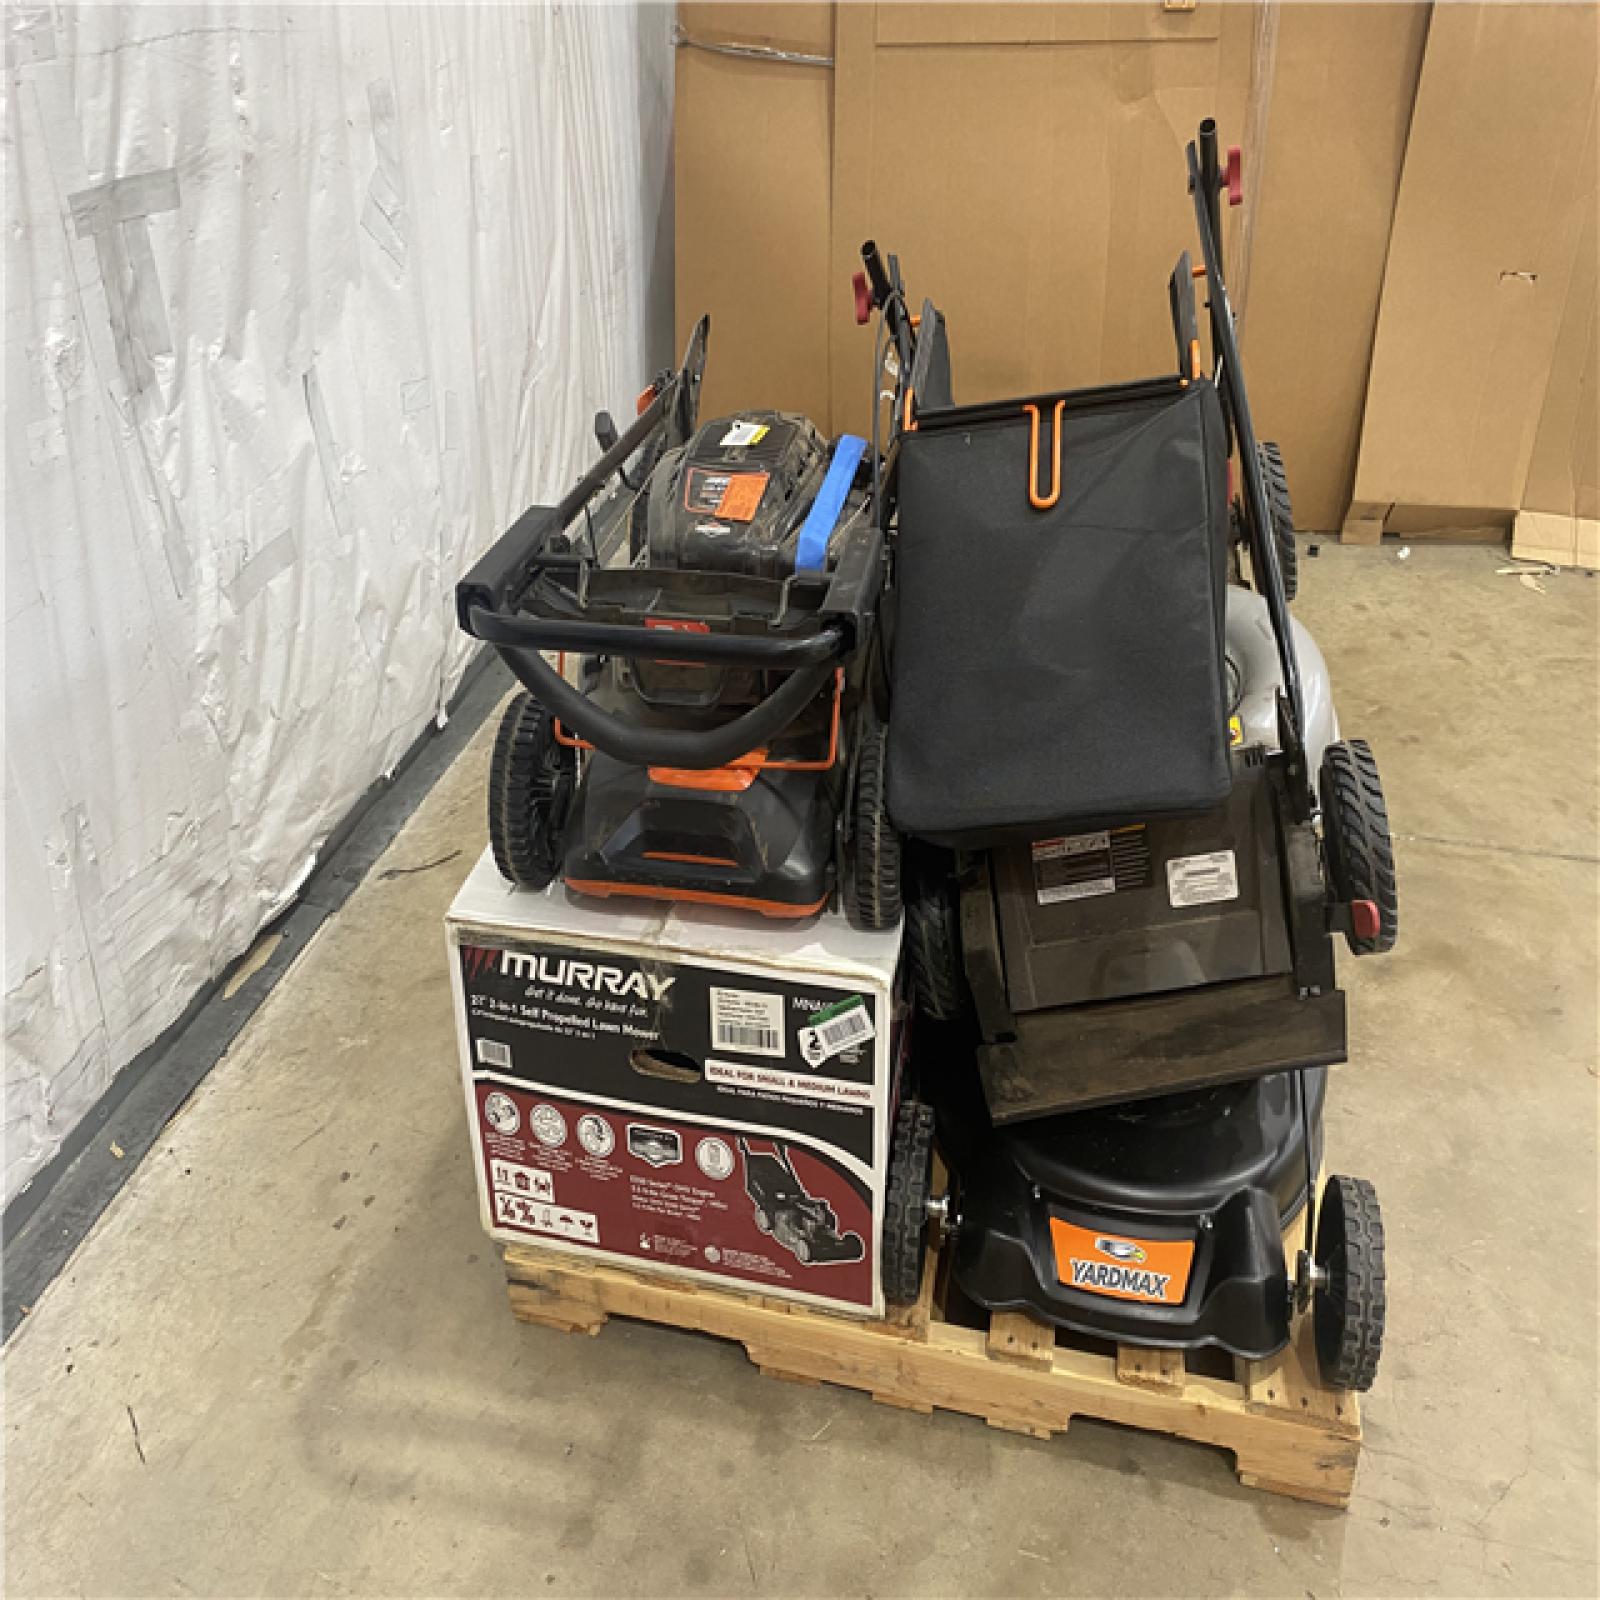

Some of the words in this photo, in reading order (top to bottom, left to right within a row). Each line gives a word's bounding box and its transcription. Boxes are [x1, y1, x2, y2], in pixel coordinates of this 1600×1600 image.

[500, 950, 676, 1001] MURRAY
[736, 1069, 755, 1081] FOR
[757, 1073, 785, 1087] SMALL
[797, 1079, 836, 1094] MEDIUM
[837, 1085, 872, 1101] LAWNS
[1071, 1258, 1170, 1300] YARDMAX
